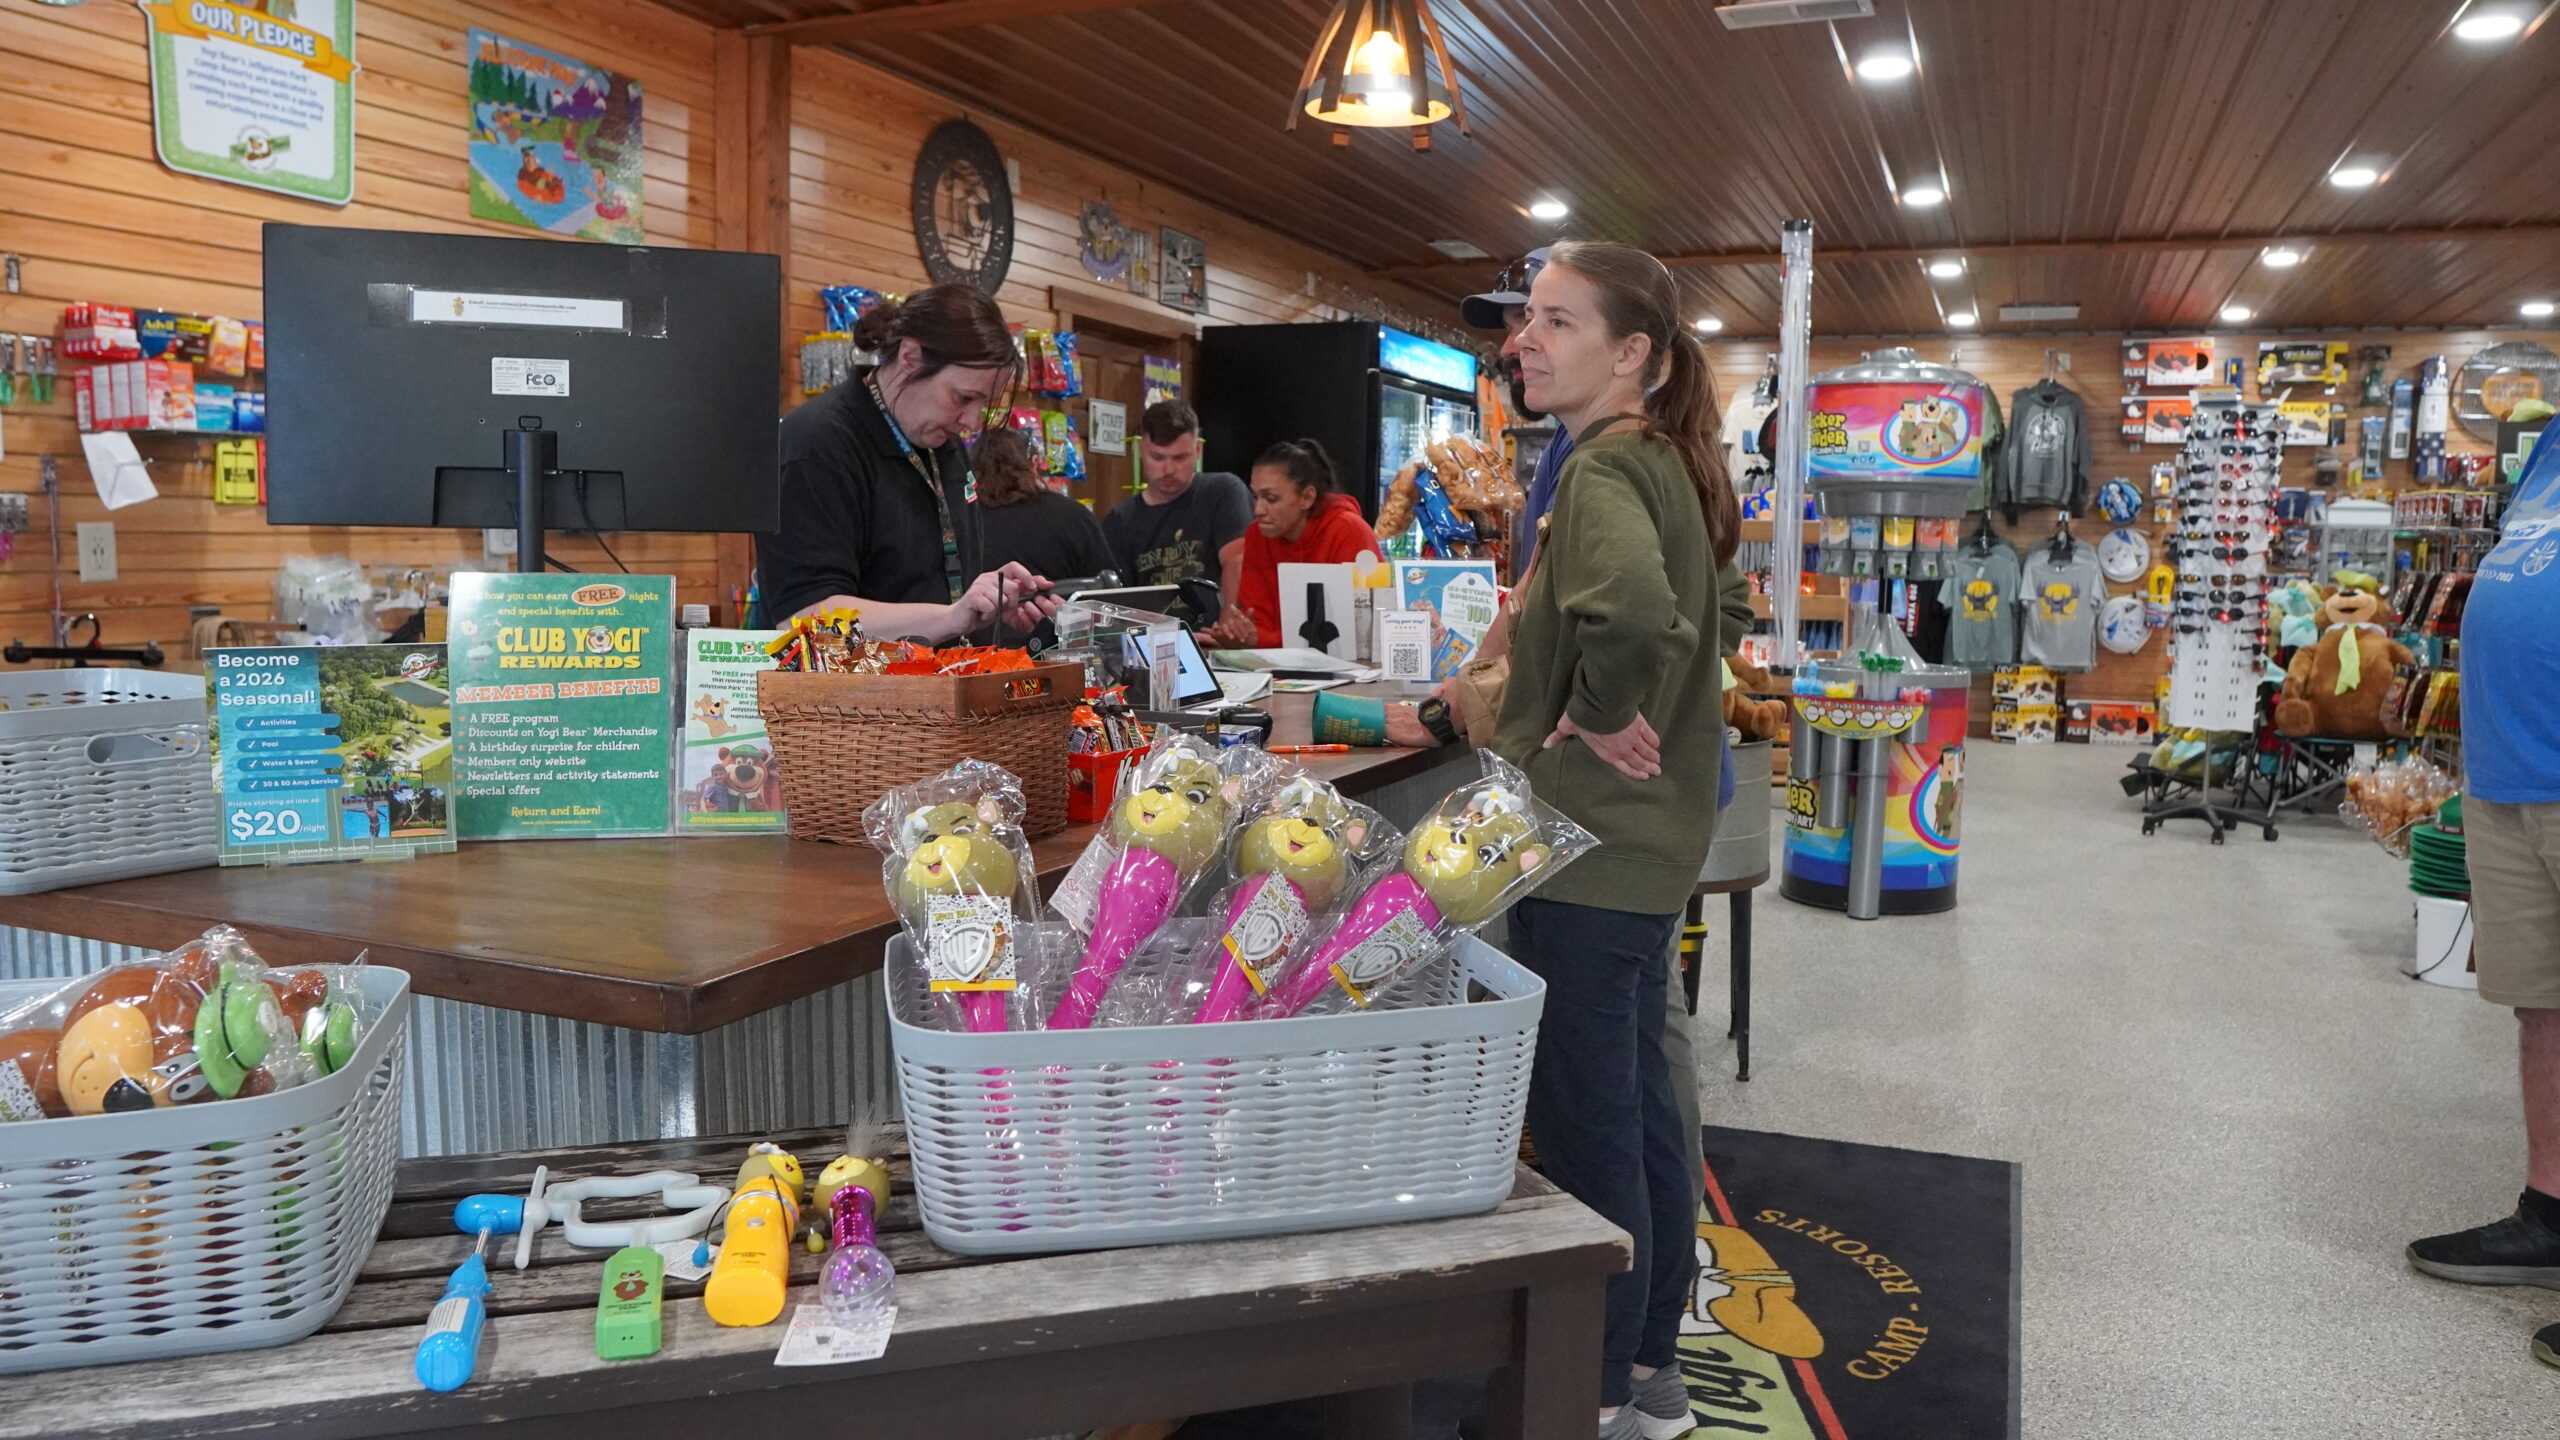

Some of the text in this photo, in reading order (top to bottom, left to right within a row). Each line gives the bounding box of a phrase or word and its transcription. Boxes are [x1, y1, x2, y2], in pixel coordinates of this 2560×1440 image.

[190, 1, 317, 58] OUR PLEDGE
[143, 319, 175, 331] Advil
[2124, 367, 2146, 377] FLEX
[1101, 413, 1124, 430] STAFF
[2122, 424, 2144, 434] FLEX
[1102, 430, 1123, 445] ONLY
[507, 592, 525, 603] you
[527, 592, 545, 601] can
[546, 592, 568, 601] earn
[578, 587, 620, 603] FREE
[628, 590, 659, 603] nights
[1449, 593, 1493, 604] SPECIAL
[497, 607, 516, 616] and
[518, 606, 553, 618] special
[555, 606, 595, 616] benefits
[1466, 605, 1492, 625] 100
[497, 626, 566, 654] CLUB
[697, 640, 733, 655] CLUB
[218, 653, 300, 668] Become
[499, 655, 643, 670] REWARDS
[699, 655, 771, 664] REWARDS
[219, 672, 286, 687] a 2026
[456, 677, 661, 704] MEMBER BENEFITS
[220, 689, 317, 707] Seasonal!
[260, 718, 297, 727] Activities
[469, 714, 559, 726] A FREE program
[468, 728, 518, 738] Discounts
[521, 729, 534, 738] on
[537, 728, 560, 740] Yogi
[593, 727, 658, 737] Merchandise
[2067, 727, 2089, 736] FLEX
[261, 740, 279, 748] Pool
[468, 741, 640, 755] A birthday surprise for children
[262, 760, 287, 768] Water
[294, 758, 319, 766] Sewer
[467, 756, 587, 768] Members only website
[263, 776, 340, 788] 30 & 50 Amp Service
[467, 769, 659, 783] Newsletters and activity statements
[466, 786, 541, 799] Special offers
[228, 800, 252, 808] Prices
[253, 798, 284, 808] starting
[511, 805, 601, 818] Return and Earn!
[1796, 814, 1815, 830] ART
[288, 844, 370, 856] Jellystone Park Monticello
[1753, 1209, 1929, 1381] CAMP RESORTS
